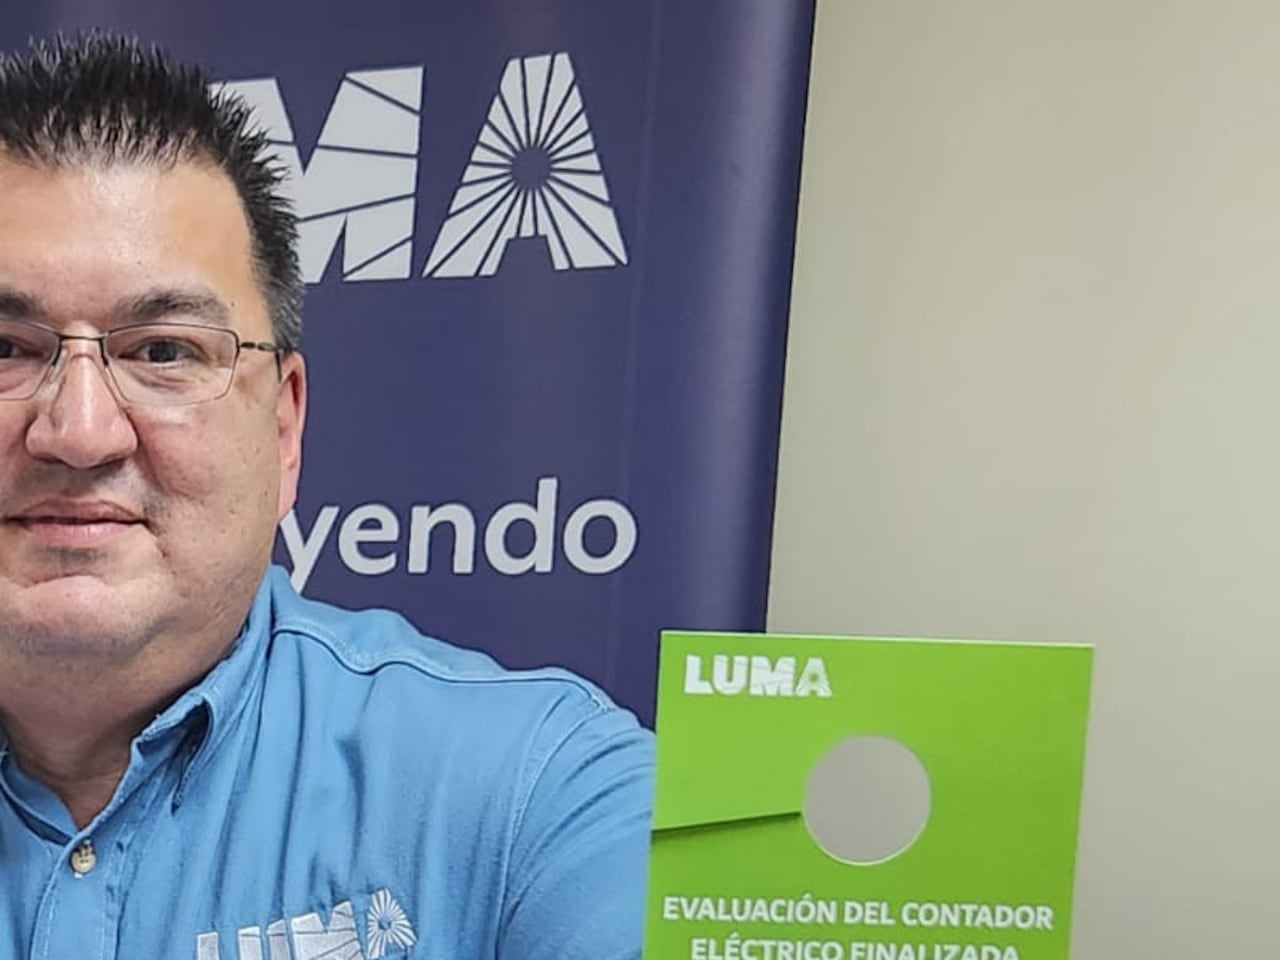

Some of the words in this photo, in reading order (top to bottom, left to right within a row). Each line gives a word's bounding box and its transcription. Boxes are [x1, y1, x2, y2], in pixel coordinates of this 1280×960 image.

[683, 653, 833, 698] LUMA
[663, 893, 837, 924] EVALUACIÓN
[843, 900, 895, 925] DEL
[901, 902, 1054, 930] CONTADOR
